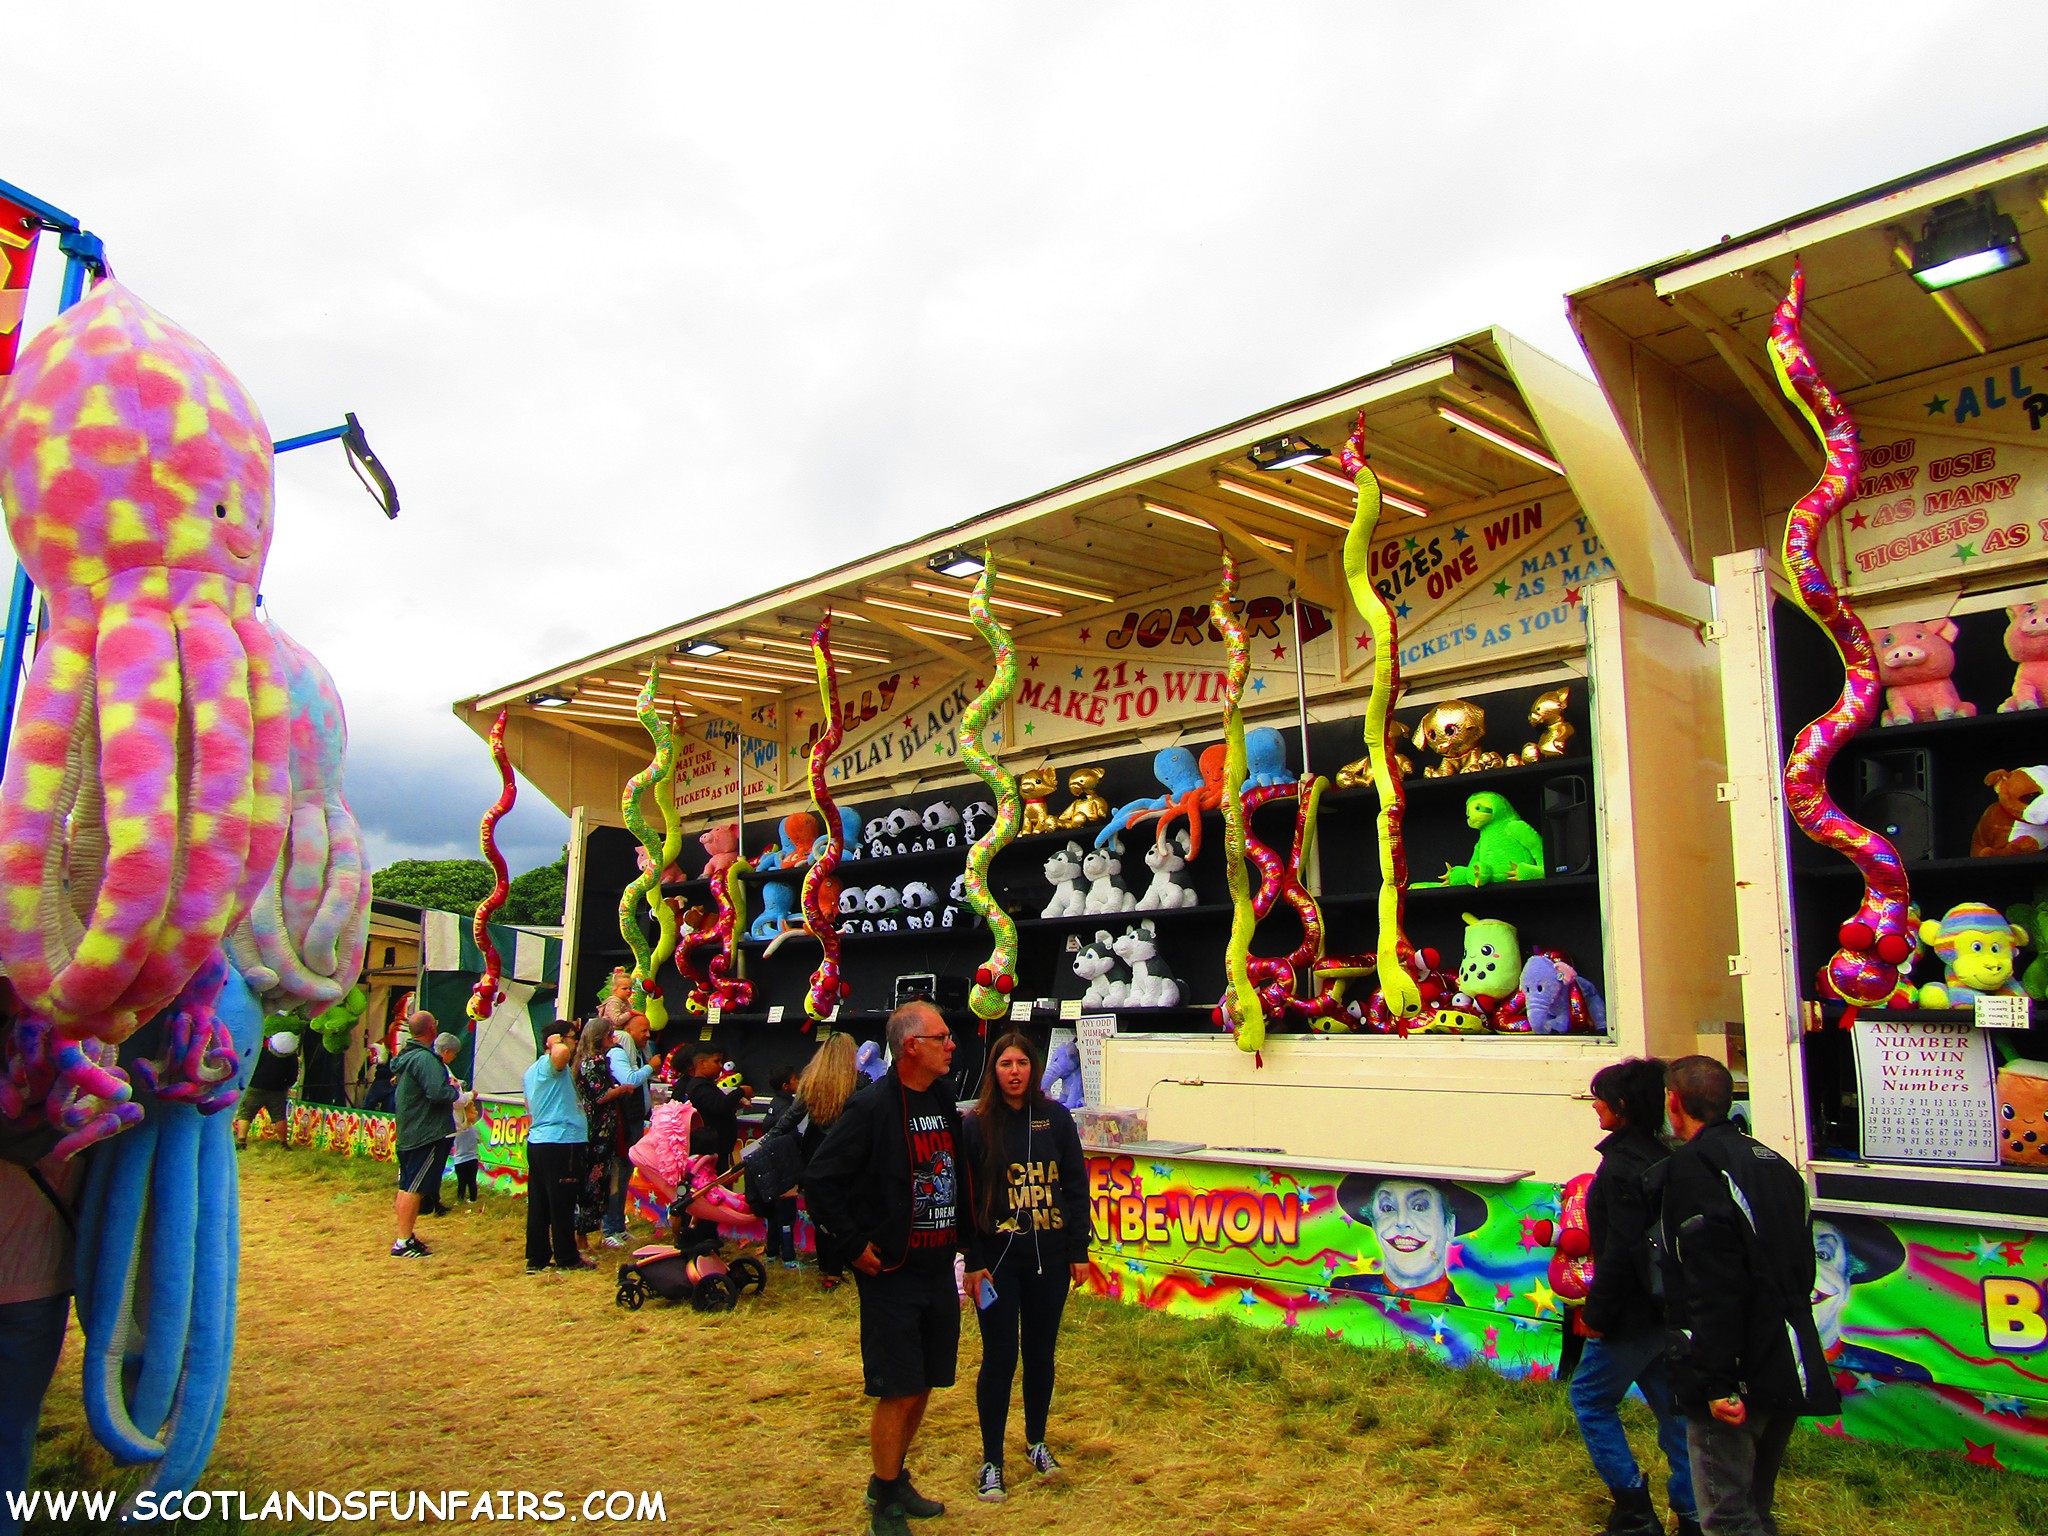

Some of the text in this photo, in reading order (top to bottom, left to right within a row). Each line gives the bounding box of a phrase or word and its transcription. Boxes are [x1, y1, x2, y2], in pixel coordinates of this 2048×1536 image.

[1955, 366, 2032, 424] ALL
[1929, 448, 1996, 482] USE
[1872, 474, 2020, 528] AS MANY
[1427, 545, 1478, 600] ONE
[1484, 502, 1543, 551] WIN
[1856, 508, 1989, 573] TICKETS
[1982, 523, 2030, 554] AS
[1371, 541, 1400, 577] IG
[1374, 537, 1443, 602] RIZES
[1521, 544, 1573, 577] MAY
[1514, 556, 1616, 601] AS MAN
[1400, 623, 1478, 667] ICKETS
[1481, 625, 1512, 648] AS
[1519, 604, 1570, 635] YOU
[1093, 661, 1129, 694] 21
[1016, 677, 1110, 728] MAKE
[1112, 686, 1159, 723] TO
[842, 732, 894, 780] PLAY
[898, 681, 972, 764] BLACK
[696, 750, 712, 764] USE
[676, 761, 717, 783] AS MANY
[676, 786, 710, 810] TICKETS
[711, 787, 722, 800] AS
[742, 780, 764, 796] LIKE
[1096, 1019, 1112, 1027] ODD
[1870, 1023, 1971, 1034] ANY ODD
[1875, 1036, 1969, 1048] NUMBER
[1882, 1050, 1964, 1062] TO WIN
[1882, 1066, 1965, 1080] Winning
[1882, 1080, 1969, 1092] Numbers
[912, 1116, 944, 1131] I DON'T
[1868, 1116, 1876, 1124] 39
[1925, 1118, 1934, 1126] 47
[1982, 1120, 1991, 1128] 55
[1922, 1108, 1930, 1116] 29
[1950, 1109, 1959, 1117] 33
[490, 1118, 518, 1146] BIG
[1940, 1138, 1948, 1146] 85
[1968, 1139, 1977, 1147] 89
[1983, 1140, 1992, 1148] 91
[1983, 1130, 1992, 1138] 73
[1007, 1161, 1059, 1185] CHA
[1008, 1185, 1052, 1210] MPI
[1119, 1194, 1170, 1243] BE
[1177, 1192, 1300, 1246] WON
